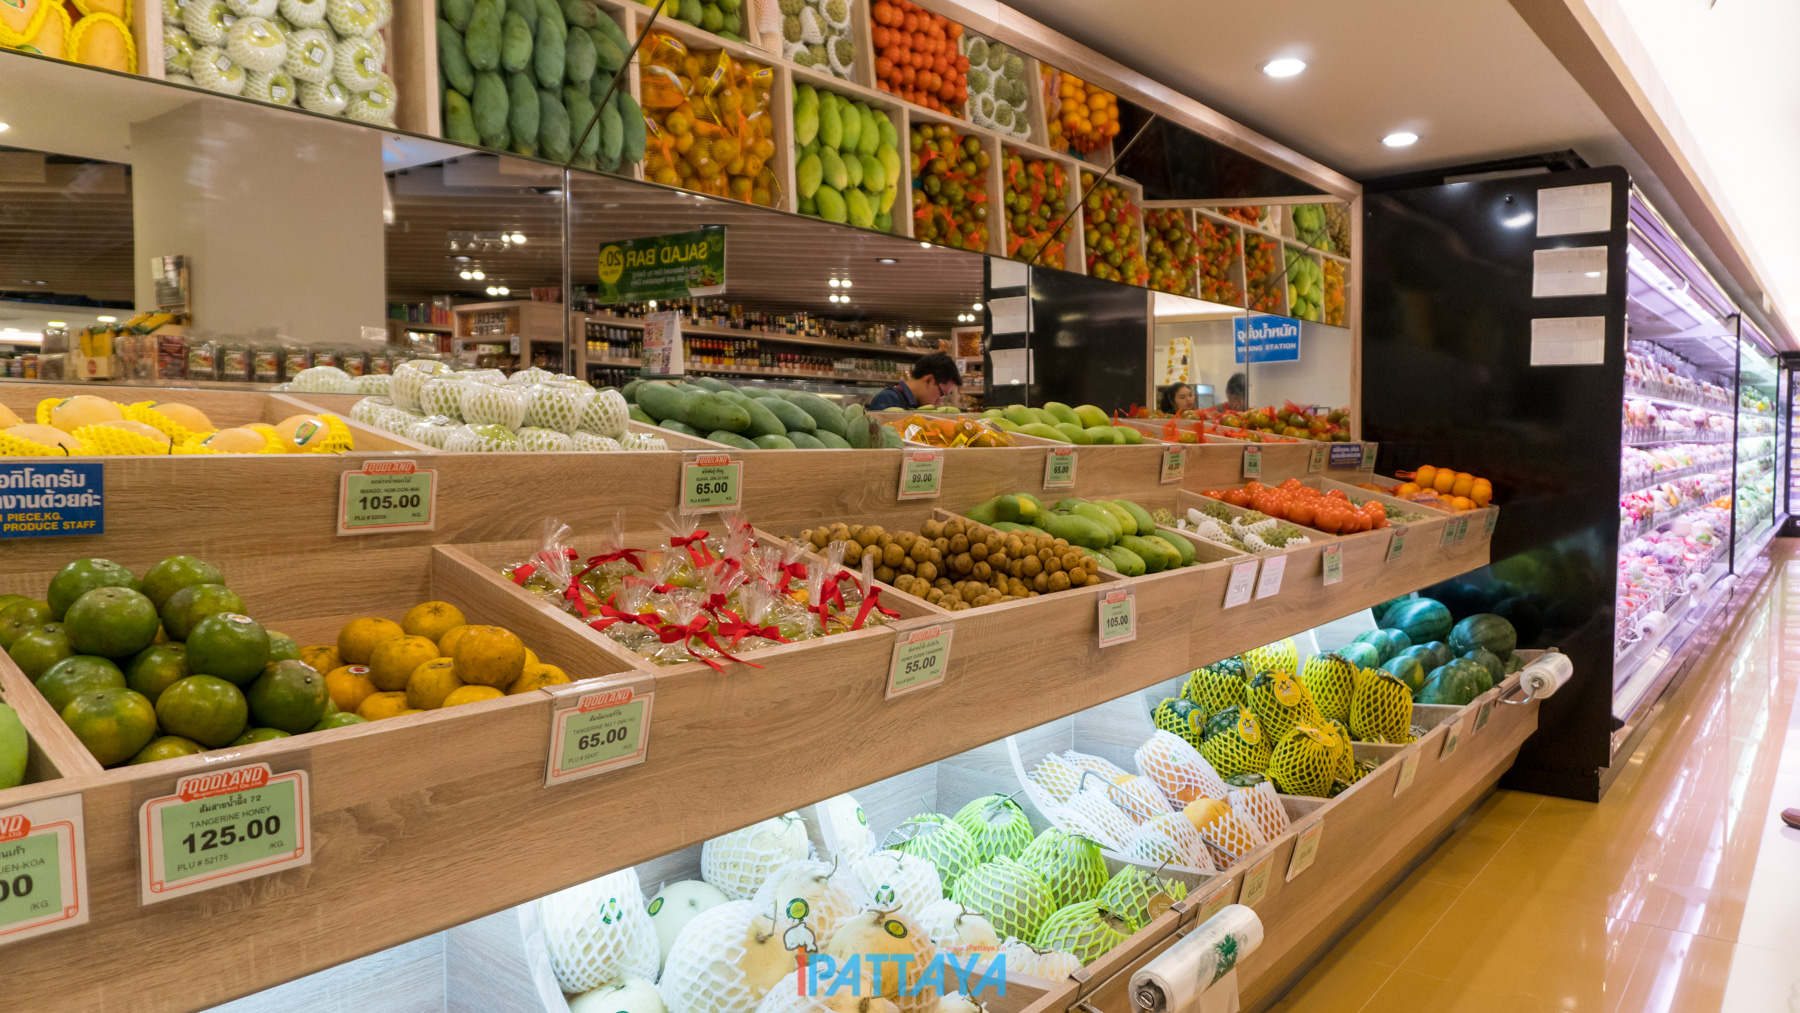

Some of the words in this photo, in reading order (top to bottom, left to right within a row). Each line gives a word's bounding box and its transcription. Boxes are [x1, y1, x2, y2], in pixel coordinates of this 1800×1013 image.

[1265, 342, 1297, 351] STATION
[364, 462, 413, 472] FOODLAND
[912, 473, 932, 483] 99.00
[696, 482, 728, 495] 65.00
[0, 488, 101, 510] งานด้วยค่ะ
[358, 494, 421, 511] 105.00
[3, 521, 59, 532] PRODUCE
[62, 520, 97, 530] STAFF
[1106, 614, 1129, 629] 105.00
[905, 655, 936, 675] 55.00
[580, 689, 631, 709] FOODLAND
[573, 723, 603, 735] TANGERINE
[578, 726, 627, 751] 65.00
[180, 766, 263, 796] FOODLAND
[250, 795, 262, 804] 72
[189, 811, 240, 830] TANGERINE
[242, 805, 272, 819] HONEY
[182, 815, 281, 854] 125.00
[177, 861, 195, 872] PLU
[197, 859, 203, 867] #
[204, 853, 229, 866] 52175
